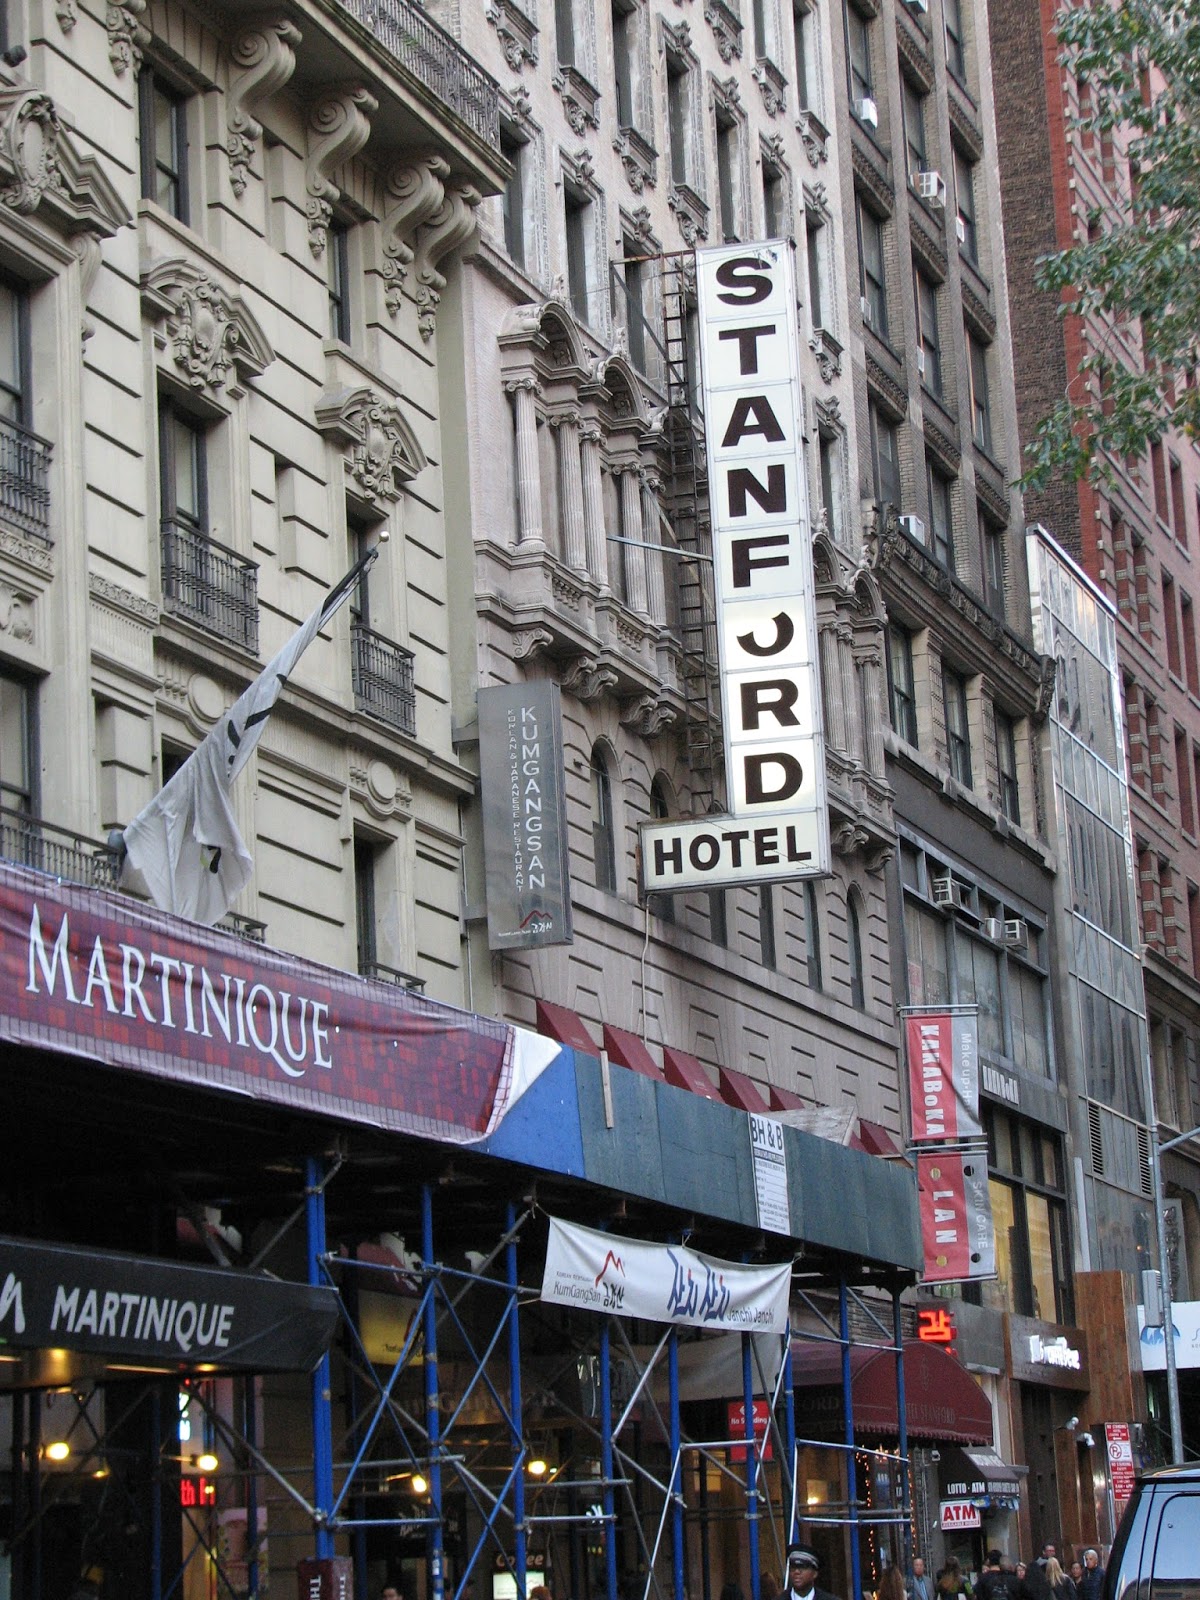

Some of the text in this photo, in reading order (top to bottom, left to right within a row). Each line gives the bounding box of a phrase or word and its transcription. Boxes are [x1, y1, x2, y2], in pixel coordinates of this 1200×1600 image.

[510, 763, 520, 818] JAPANESE
[520, 706, 546, 890] KUMGANGSAN
[654, 825, 811, 876] HOTEL
[26, 903, 332, 1077] MARTINIQUE
[750, 1117, 783, 1150] BH & B
[933, 1190, 957, 1243] LAN
[973, 1181, 985, 1212] SKIN
[553, 1281, 601, 1304] KumGangSan
[50, 1284, 235, 1353] MARTINIQUE
[727, 1306, 774, 1324] Janchi Janchi
[947, 1483, 967, 1495] LOTTO
[972, 1482, 986, 1493] ATM
[943, 1504, 977, 1521] ATM
